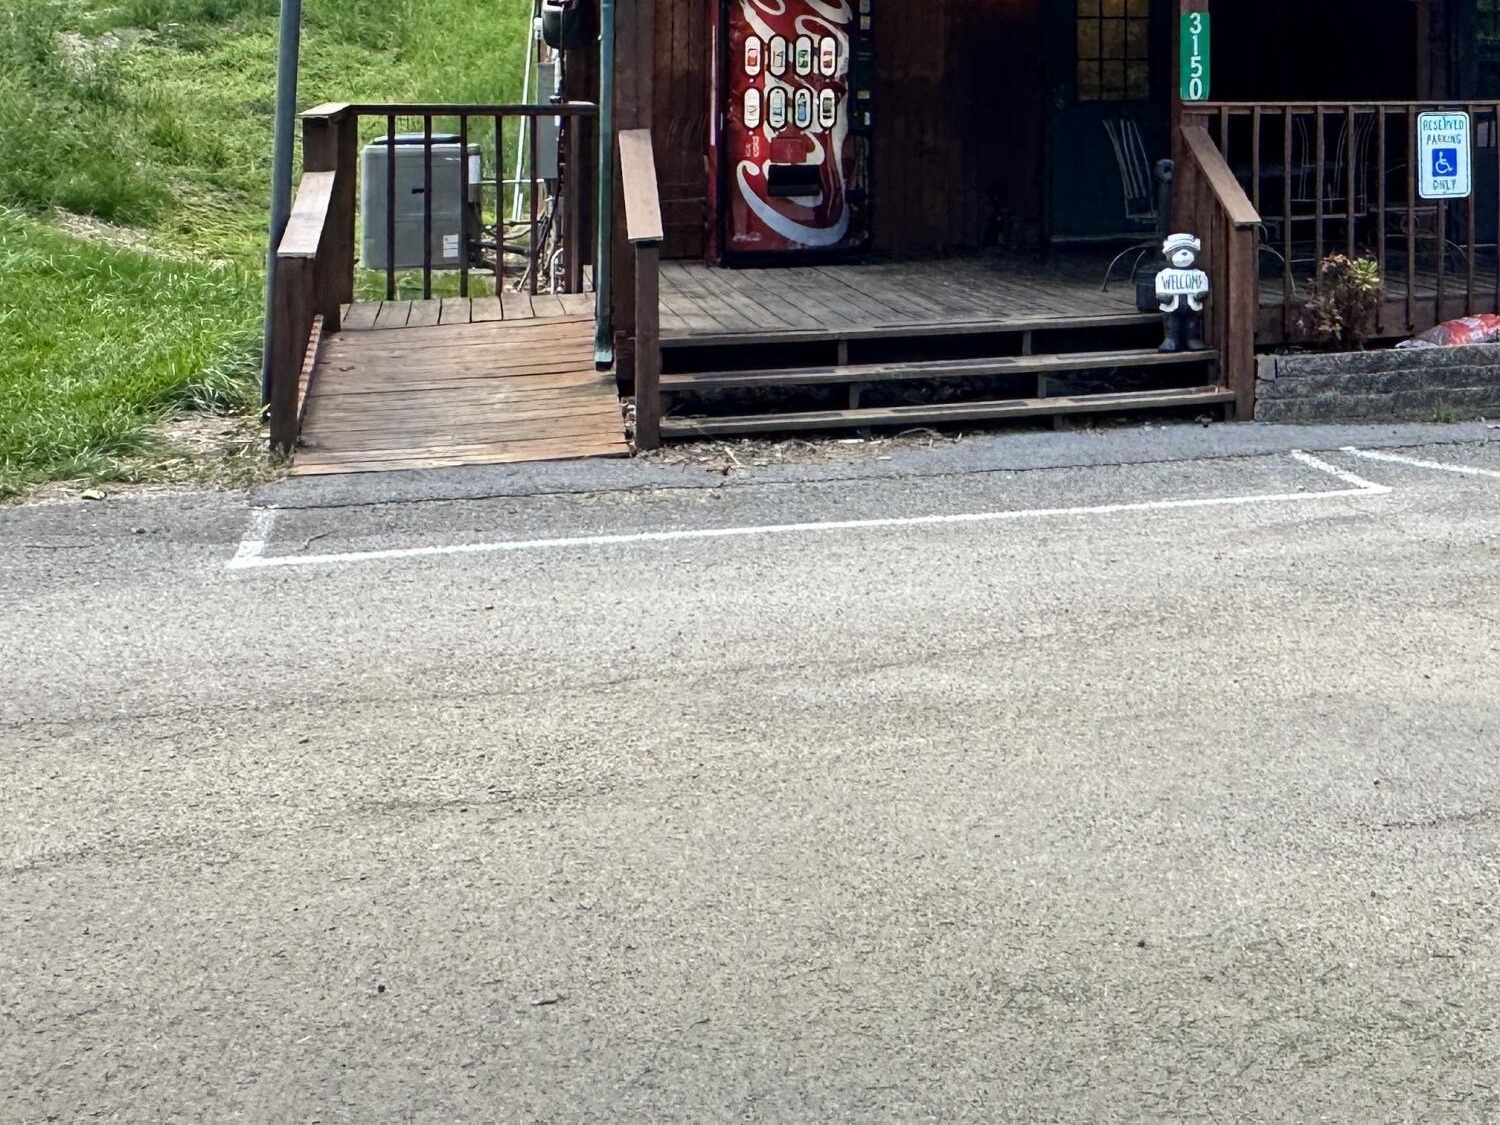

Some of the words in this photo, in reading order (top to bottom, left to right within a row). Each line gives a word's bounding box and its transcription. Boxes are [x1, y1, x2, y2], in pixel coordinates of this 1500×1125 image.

[1189, 12, 1203, 100] 3150
[1423, 119, 1464, 131] RESERVED
[1426, 134, 1461, 145] PARKING
[1432, 179, 1456, 191] ONLY
[1161, 274, 1203, 290] WELCOME
